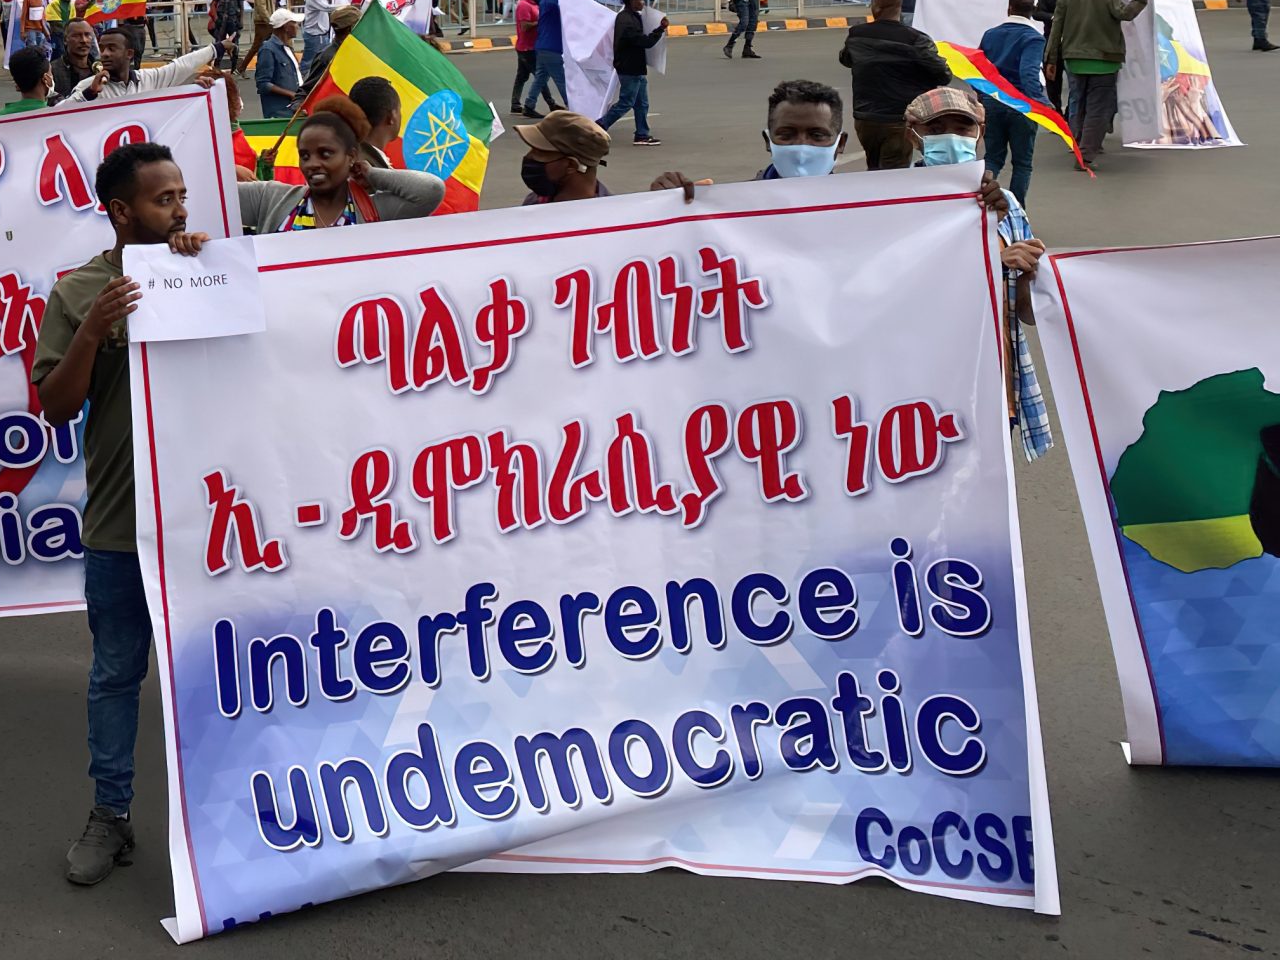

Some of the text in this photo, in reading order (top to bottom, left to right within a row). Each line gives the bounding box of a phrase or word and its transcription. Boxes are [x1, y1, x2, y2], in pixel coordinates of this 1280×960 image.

[148, 274, 228, 290] # NO MORE
[338, 246, 766, 391] ጣልቃ ገብነት
[832, 395, 964, 496] ነው
[214, 538, 991, 716] Interference is
[255, 670, 985, 849] undemocratic
